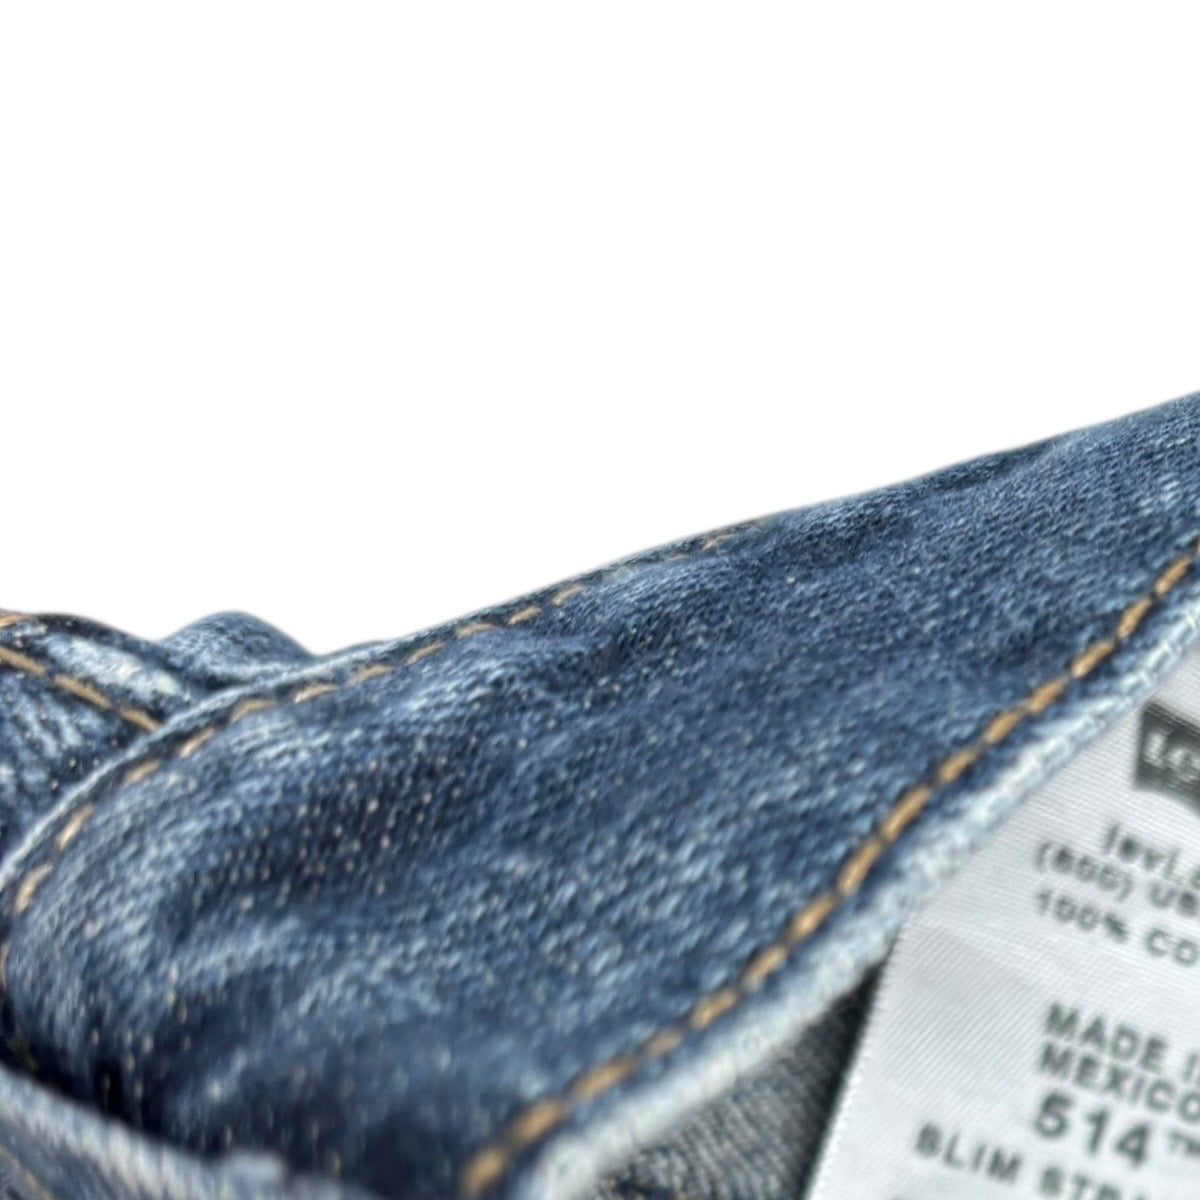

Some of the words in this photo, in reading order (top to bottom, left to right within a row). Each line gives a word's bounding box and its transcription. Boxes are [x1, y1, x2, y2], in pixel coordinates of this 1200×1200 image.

[1035, 889, 1130, 943] 100%
[1045, 1003, 1169, 1074] MADE
[914, 1123, 1023, 1186] SLIM
